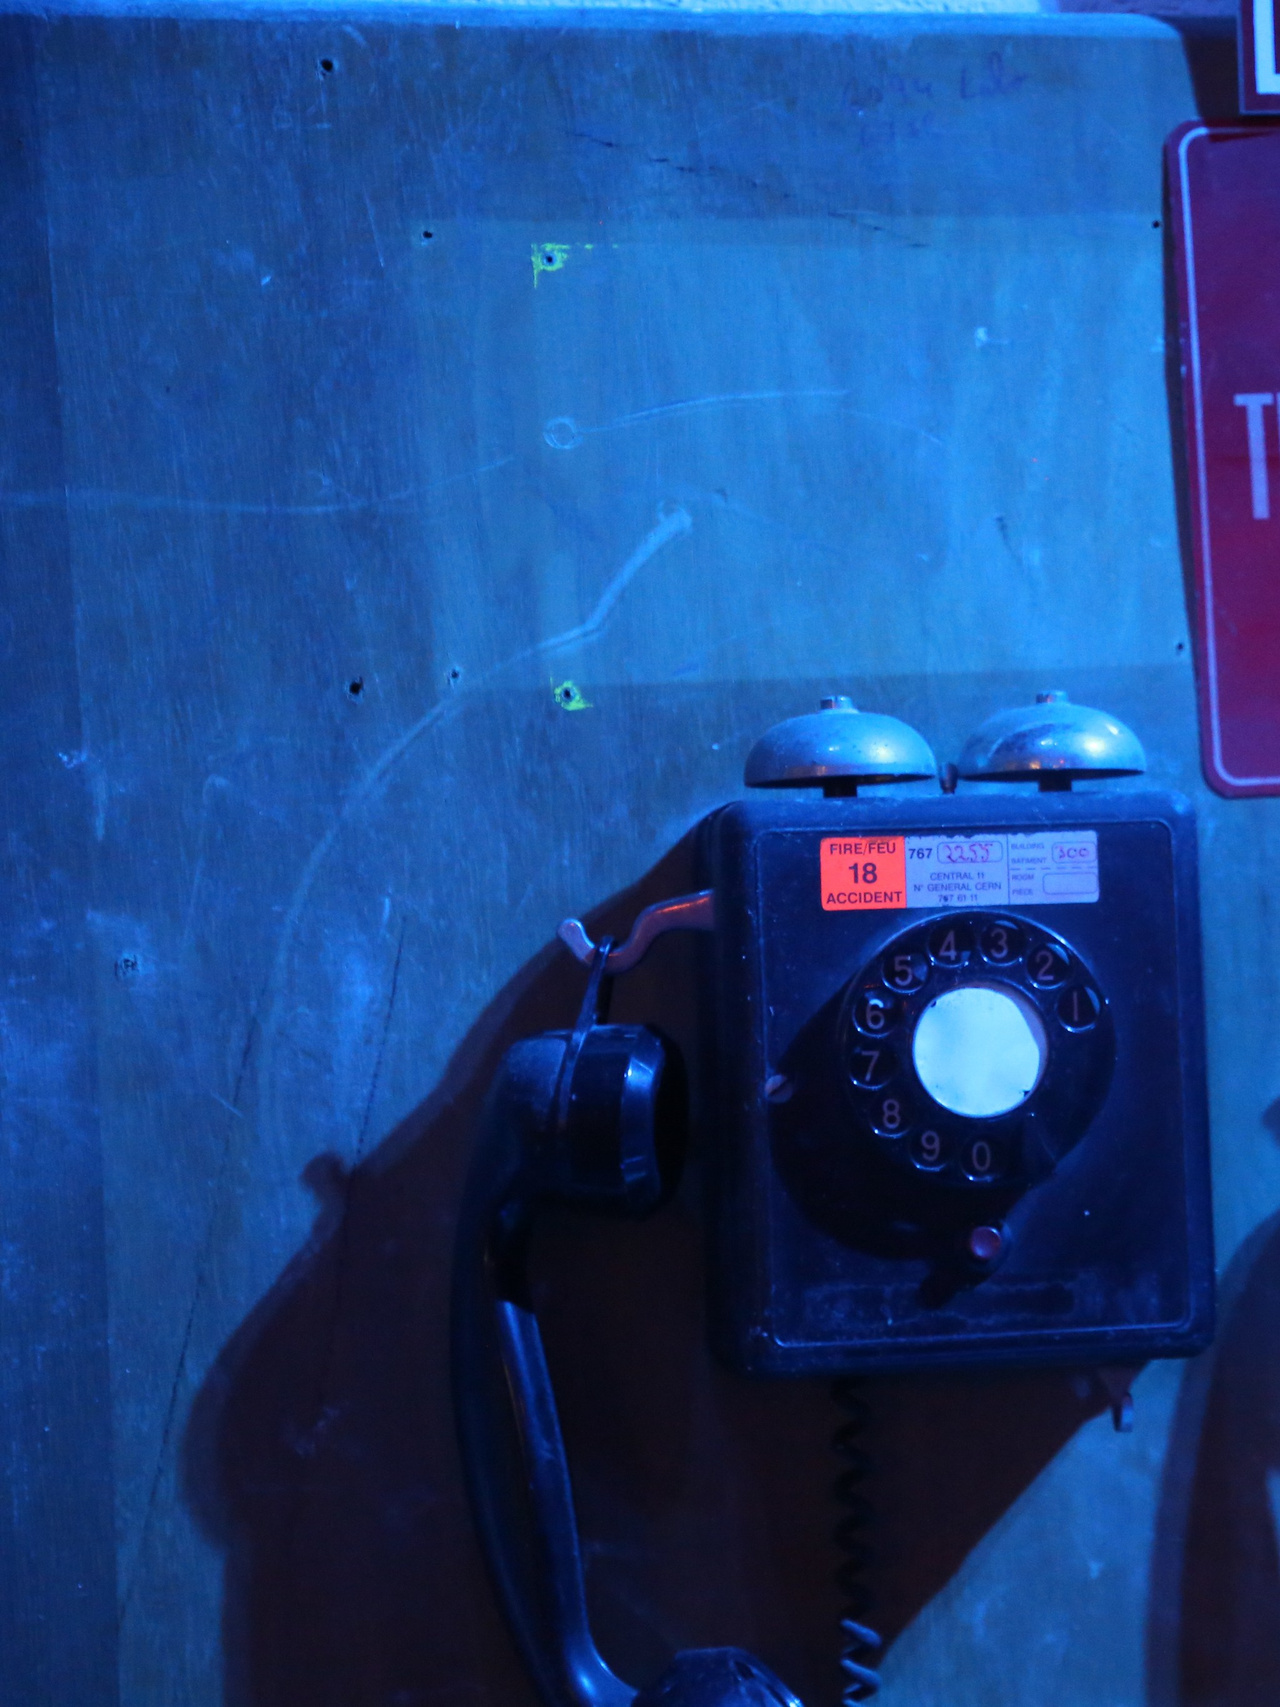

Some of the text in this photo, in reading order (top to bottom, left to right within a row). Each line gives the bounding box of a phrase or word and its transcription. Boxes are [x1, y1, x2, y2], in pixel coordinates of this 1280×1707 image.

[829, 841, 897, 856] FIRE/FEU
[908, 847, 933, 860] 767
[848, 862, 878, 884] 18
[930, 871, 974, 881] CENTRAL
[927, 882, 972, 893] GENERAL
[975, 881, 1002, 891] CERN
[826, 891, 902, 905] ACCIDENT
[861, 928, 1079, 1171] 1 2 3 4 5 6 7 8 9 0
